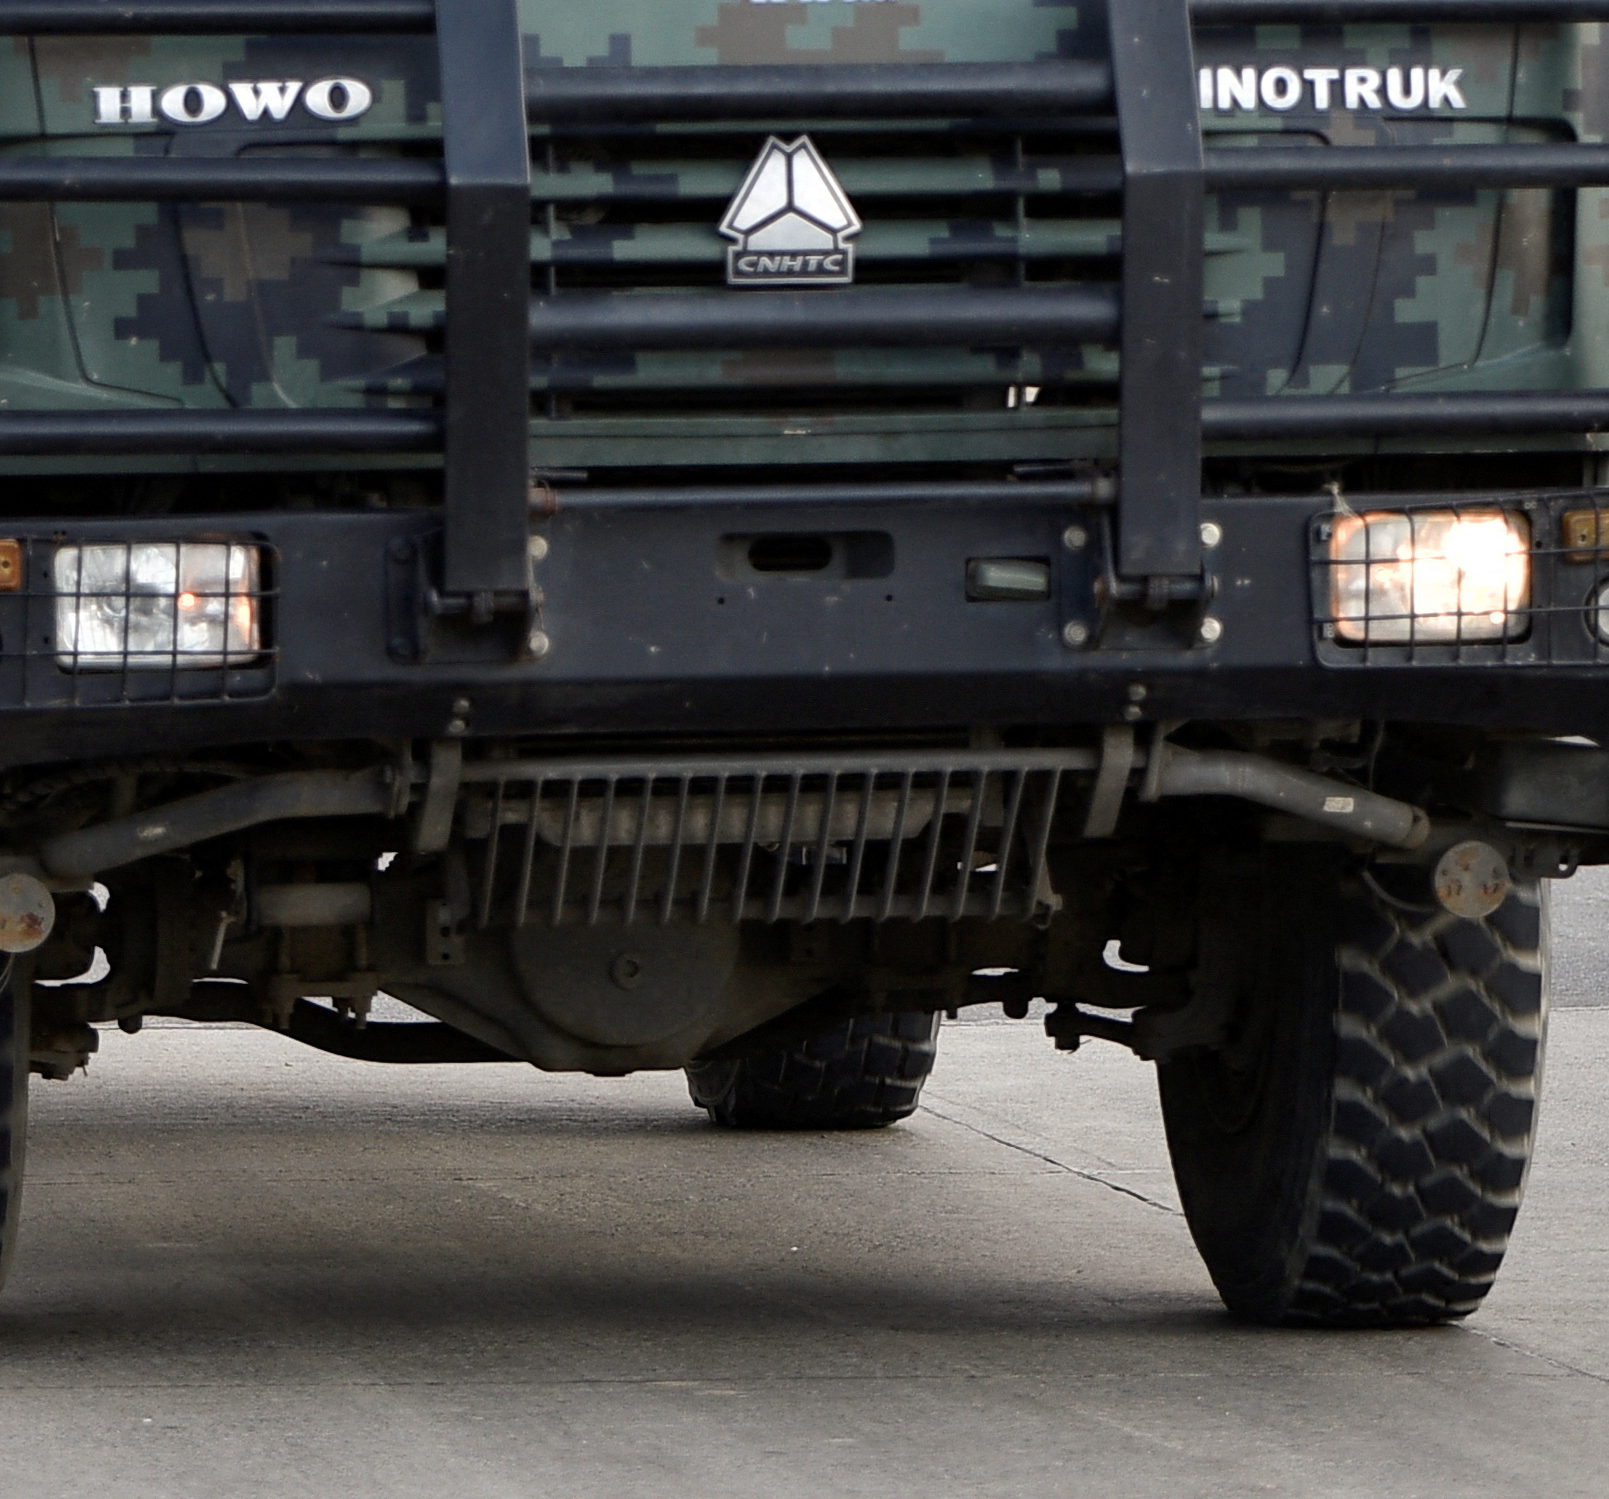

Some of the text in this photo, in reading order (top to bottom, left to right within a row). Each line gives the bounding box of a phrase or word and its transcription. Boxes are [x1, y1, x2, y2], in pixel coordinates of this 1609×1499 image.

[93, 78, 373, 125] HOWO
[1199, 66, 1466, 110] INOTRUK
[737, 255, 843, 272] CNHTC
